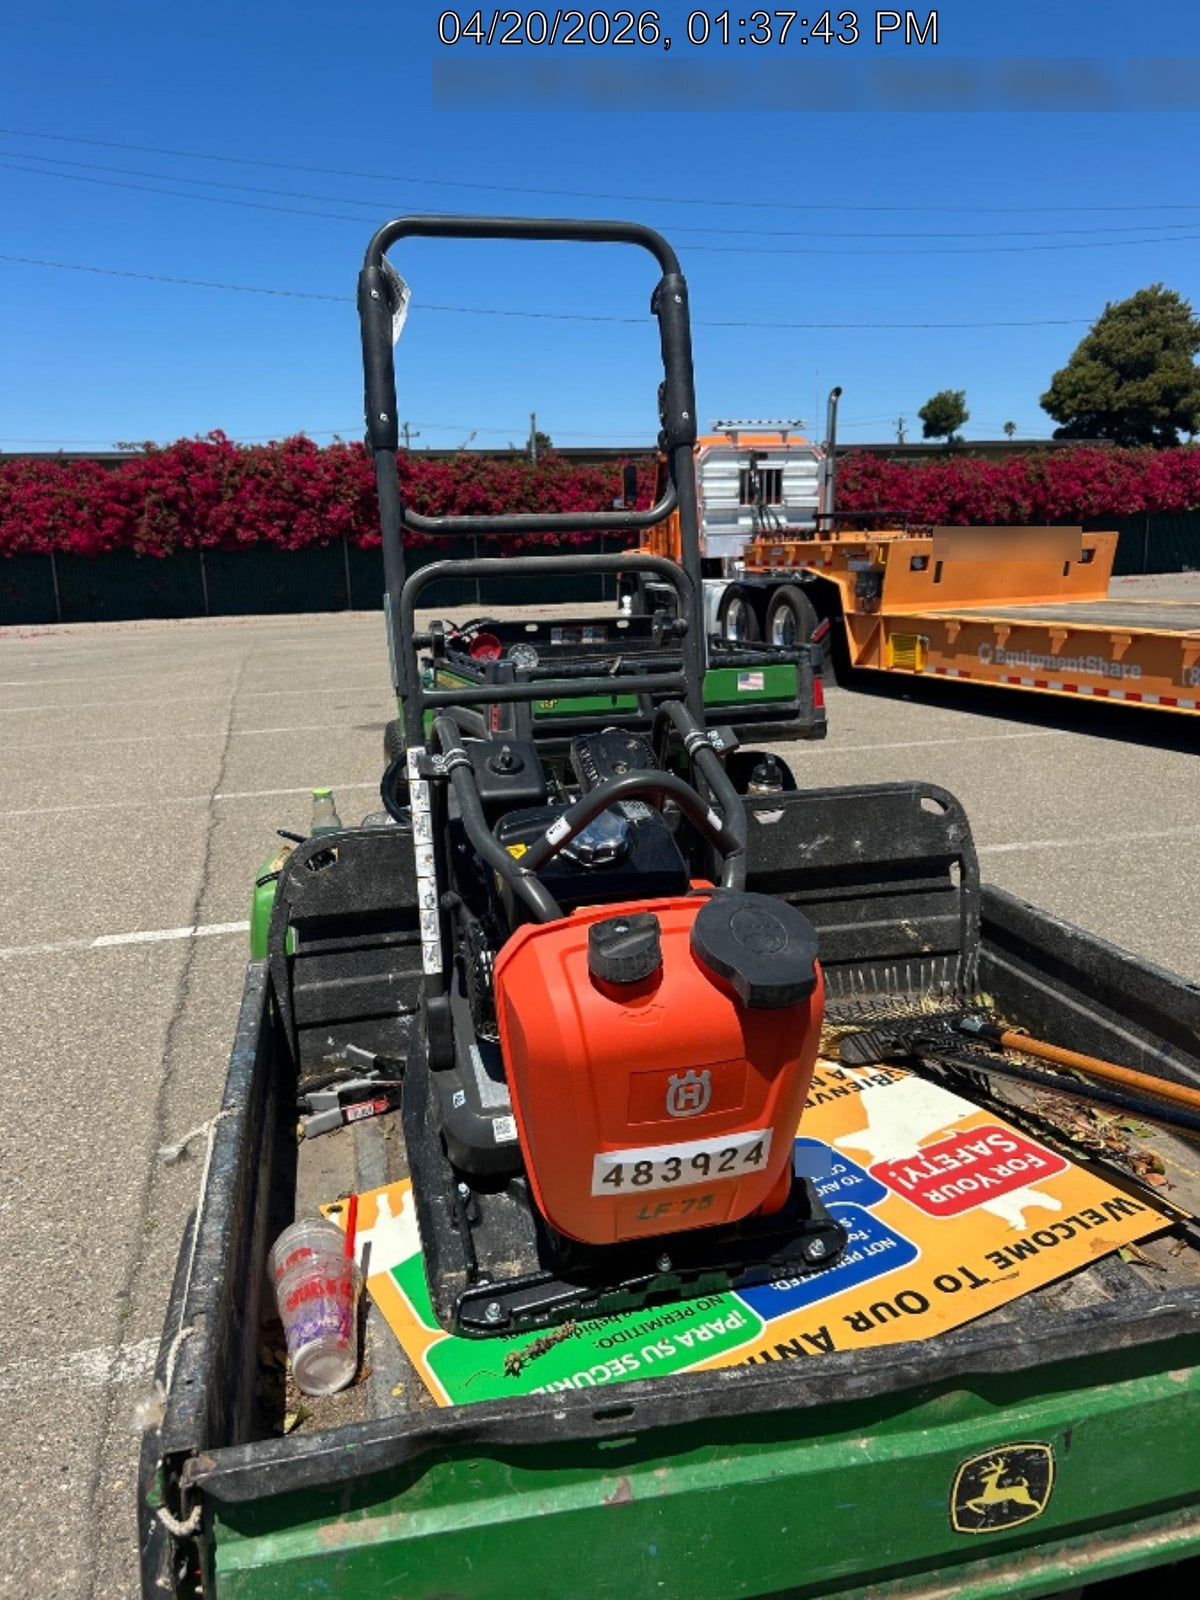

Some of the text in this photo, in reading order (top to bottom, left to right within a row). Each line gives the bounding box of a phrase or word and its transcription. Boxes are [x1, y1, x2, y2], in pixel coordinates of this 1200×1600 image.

[994, 647, 1142, 680] EquipmentShare
[602, 1140, 764, 1187] 483924
[888, 1133, 1018, 1190] SAFETY!
[922, 1152, 1047, 1203] FOR YOUR
[636, 1194, 717, 1221] LF 75
[863, 1236, 897, 1256] NOT
[984, 1196, 1147, 1271] WELCOME
[933, 1265, 991, 1294] TO
[592, 1294, 725, 1349] NO PERMITIDO:
[672, 1309, 747, 1347] ¡PARA
[841, 1288, 931, 1333] OUR
[641, 1337, 677, 1363] SU
